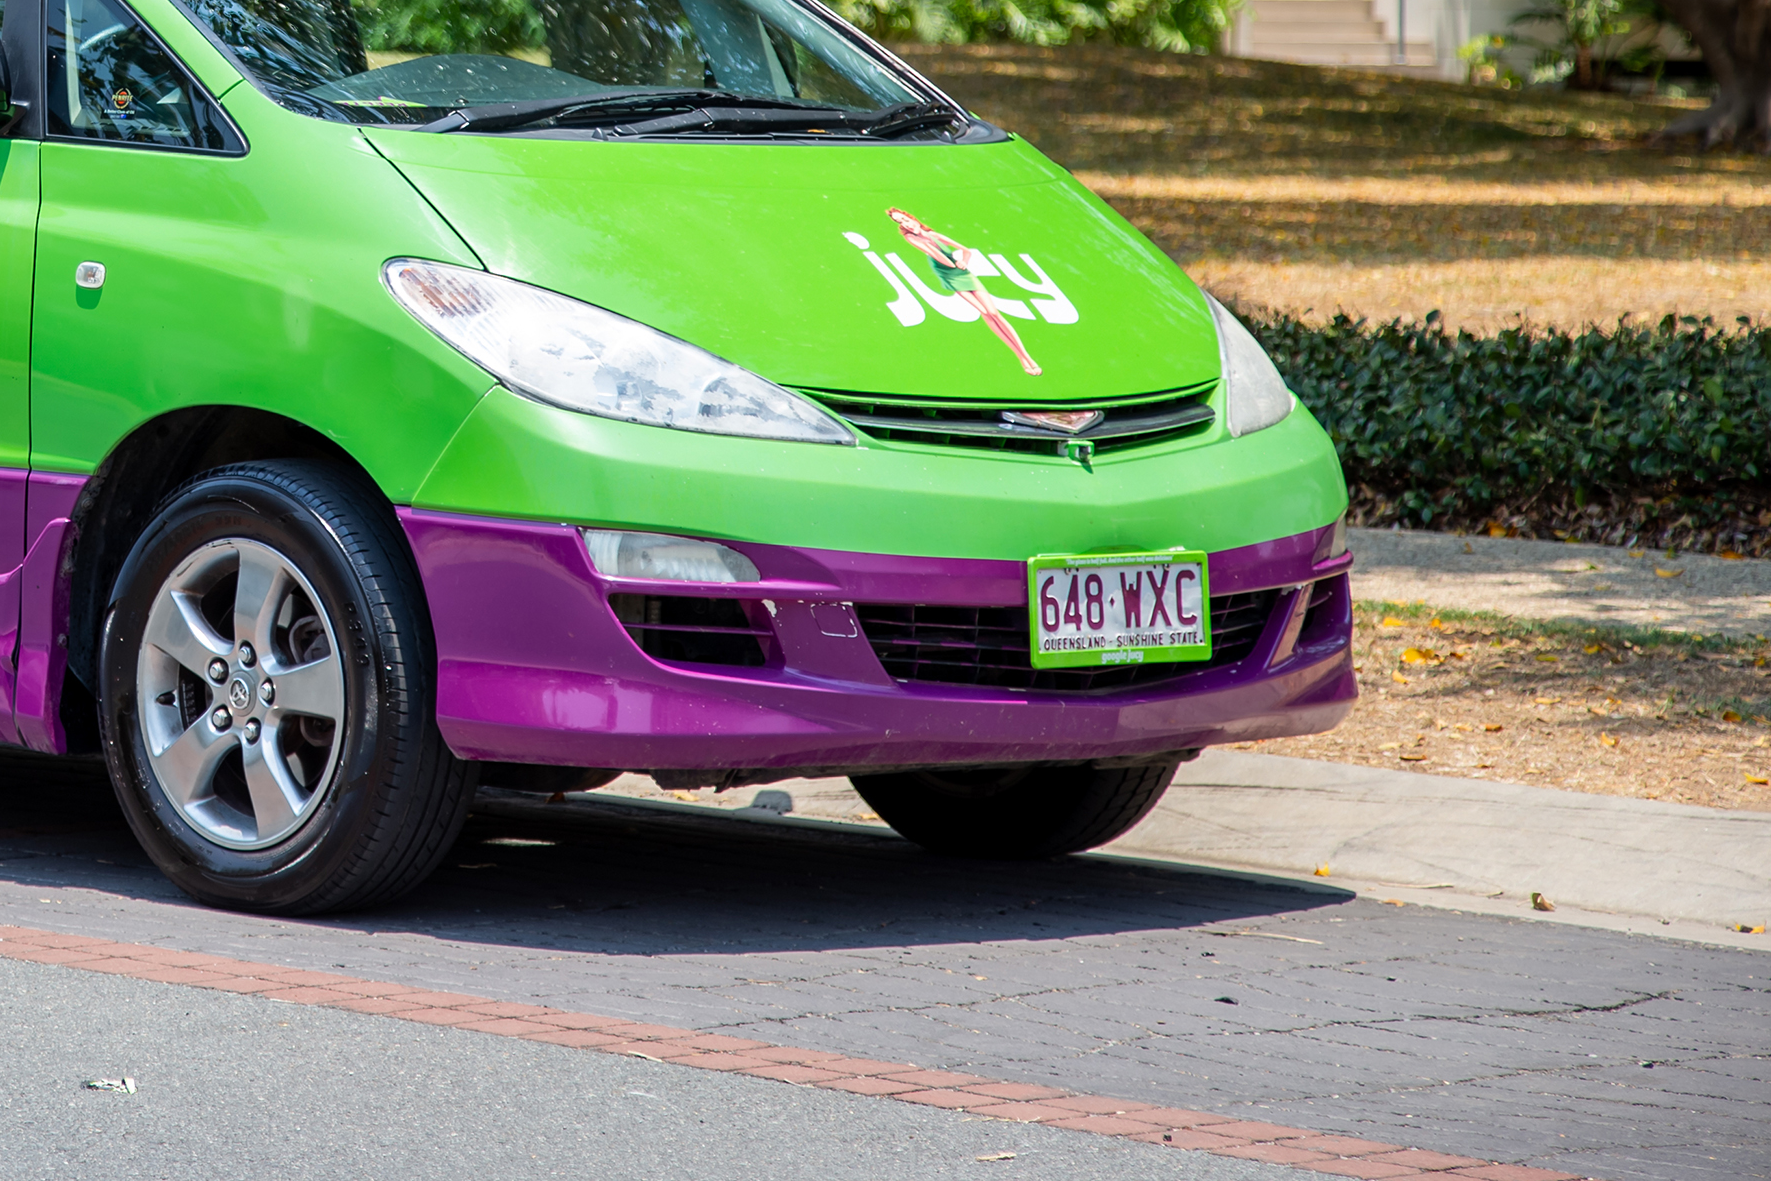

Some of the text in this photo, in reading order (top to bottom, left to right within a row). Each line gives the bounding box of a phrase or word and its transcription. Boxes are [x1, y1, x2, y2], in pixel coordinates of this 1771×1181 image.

[1044, 635, 1106, 651] QUEENSLAND
[1117, 633, 1163, 648] SUNSHINE
[1170, 631, 1198, 644] STATE
[1101, 649, 1144, 664] google jucy
